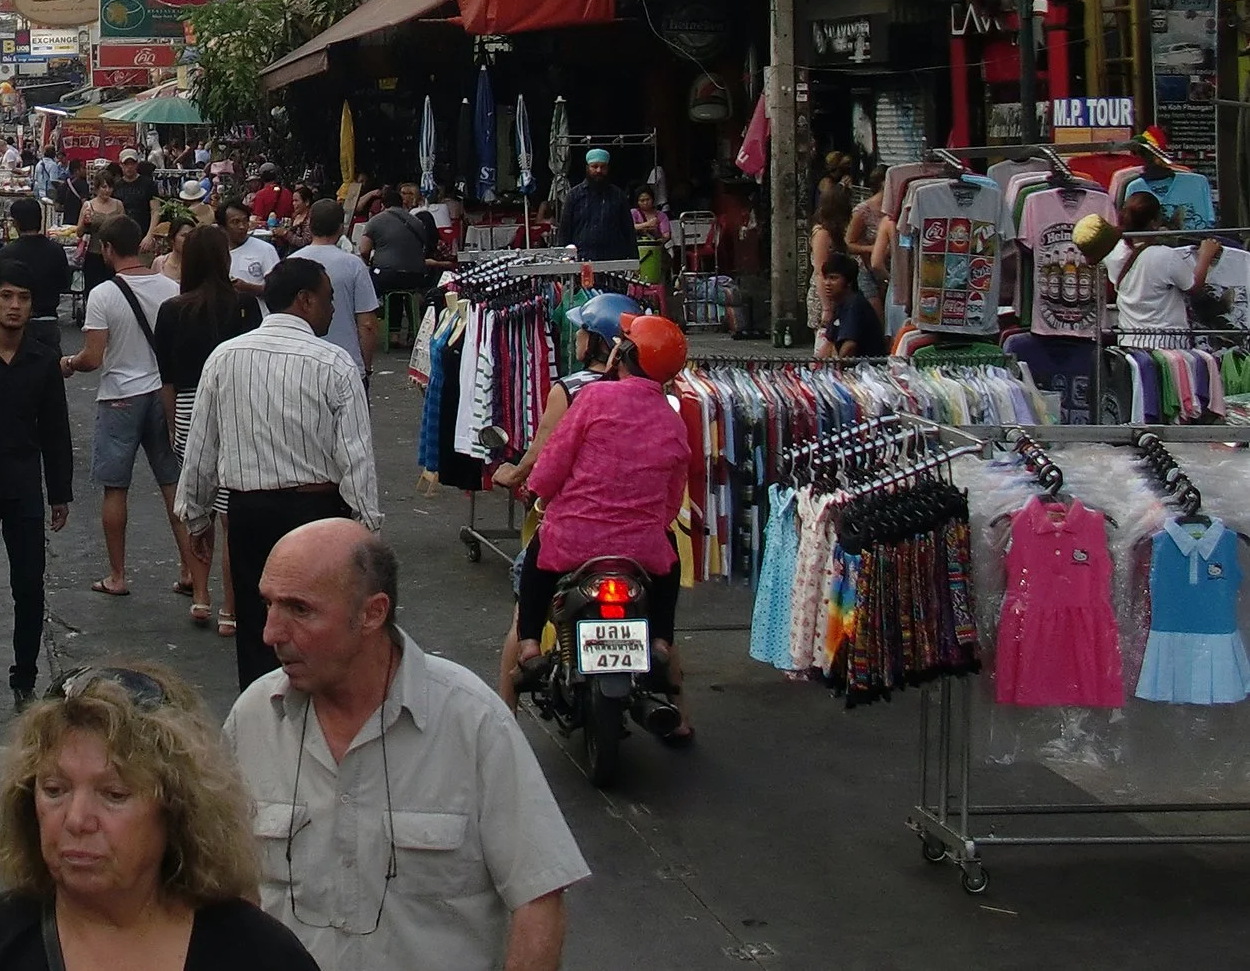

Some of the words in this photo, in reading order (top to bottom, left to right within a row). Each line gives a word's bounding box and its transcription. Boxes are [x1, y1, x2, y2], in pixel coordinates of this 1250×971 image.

[31, 35, 78, 45] EXCHANGE
[1053, 98, 1084, 127] M.P.
[1086, 98, 1133, 127] TOUR
[596, 654, 632, 668] 474
